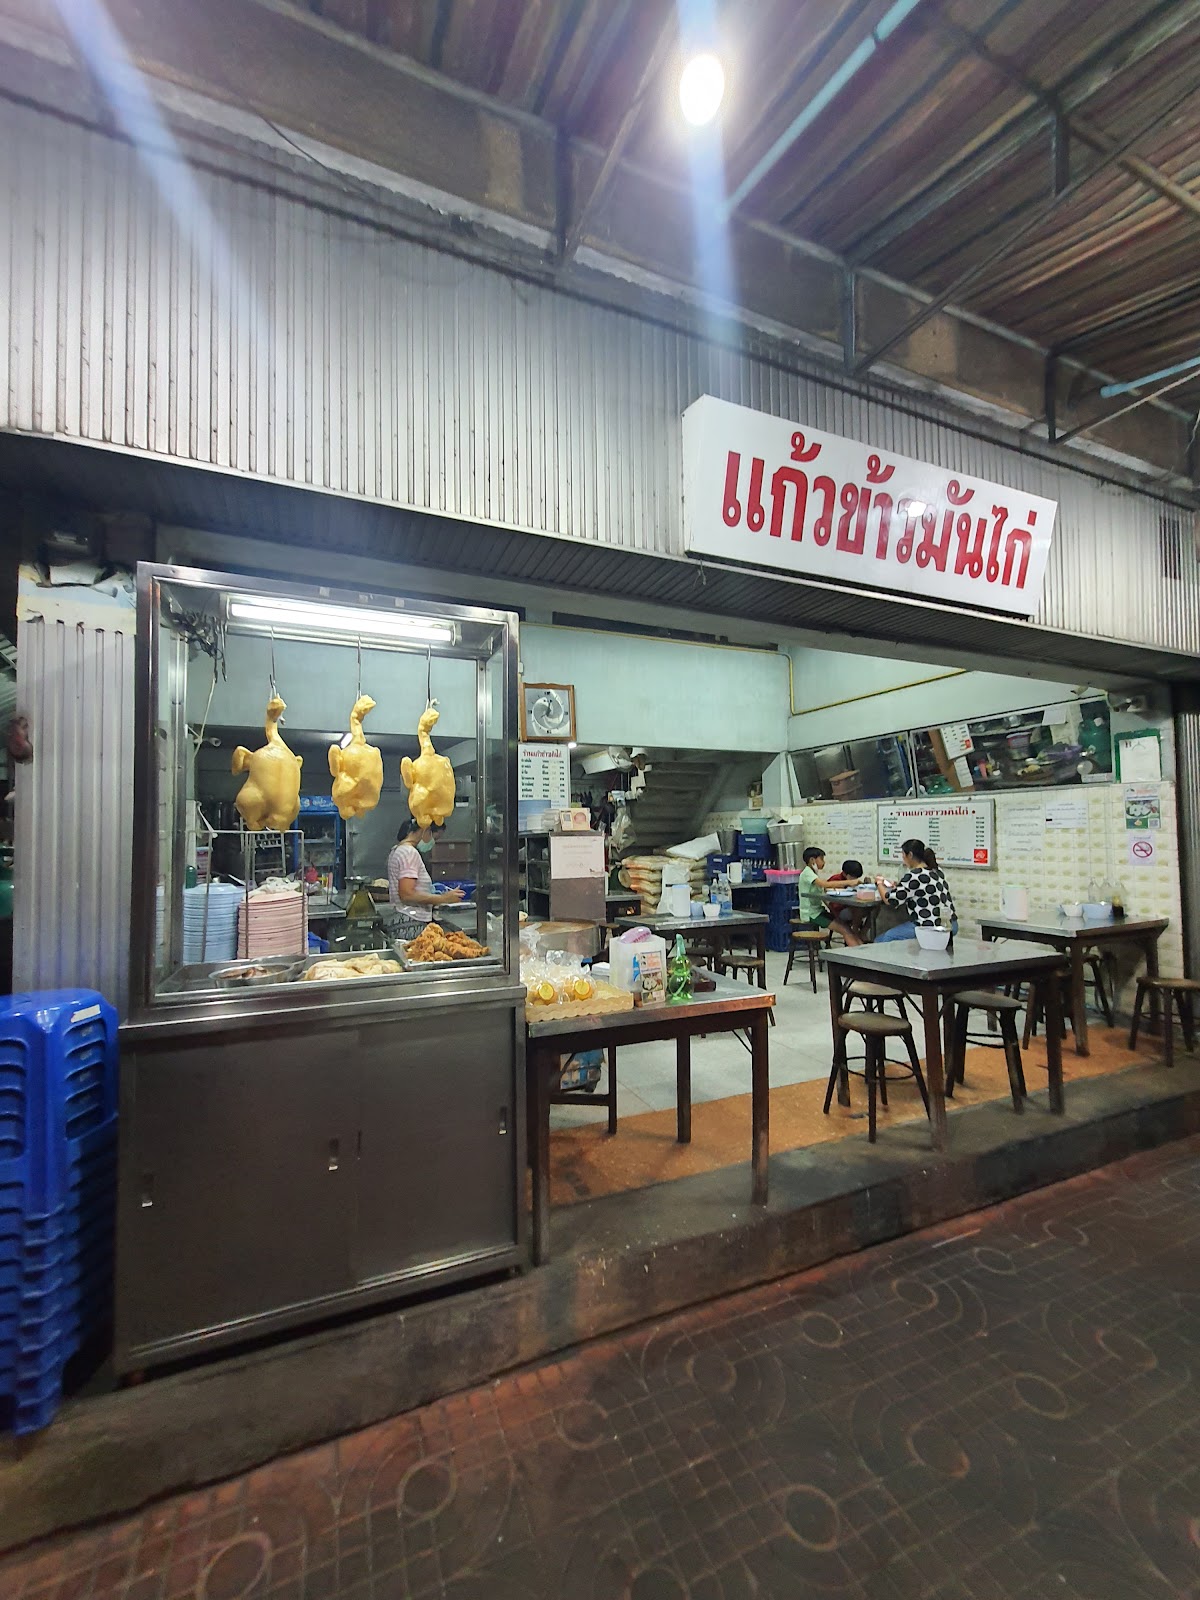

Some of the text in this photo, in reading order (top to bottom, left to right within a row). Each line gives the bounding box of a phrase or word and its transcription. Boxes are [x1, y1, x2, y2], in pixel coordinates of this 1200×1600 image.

[722, 431, 1037, 589] แก้วข้าวมันไก่
